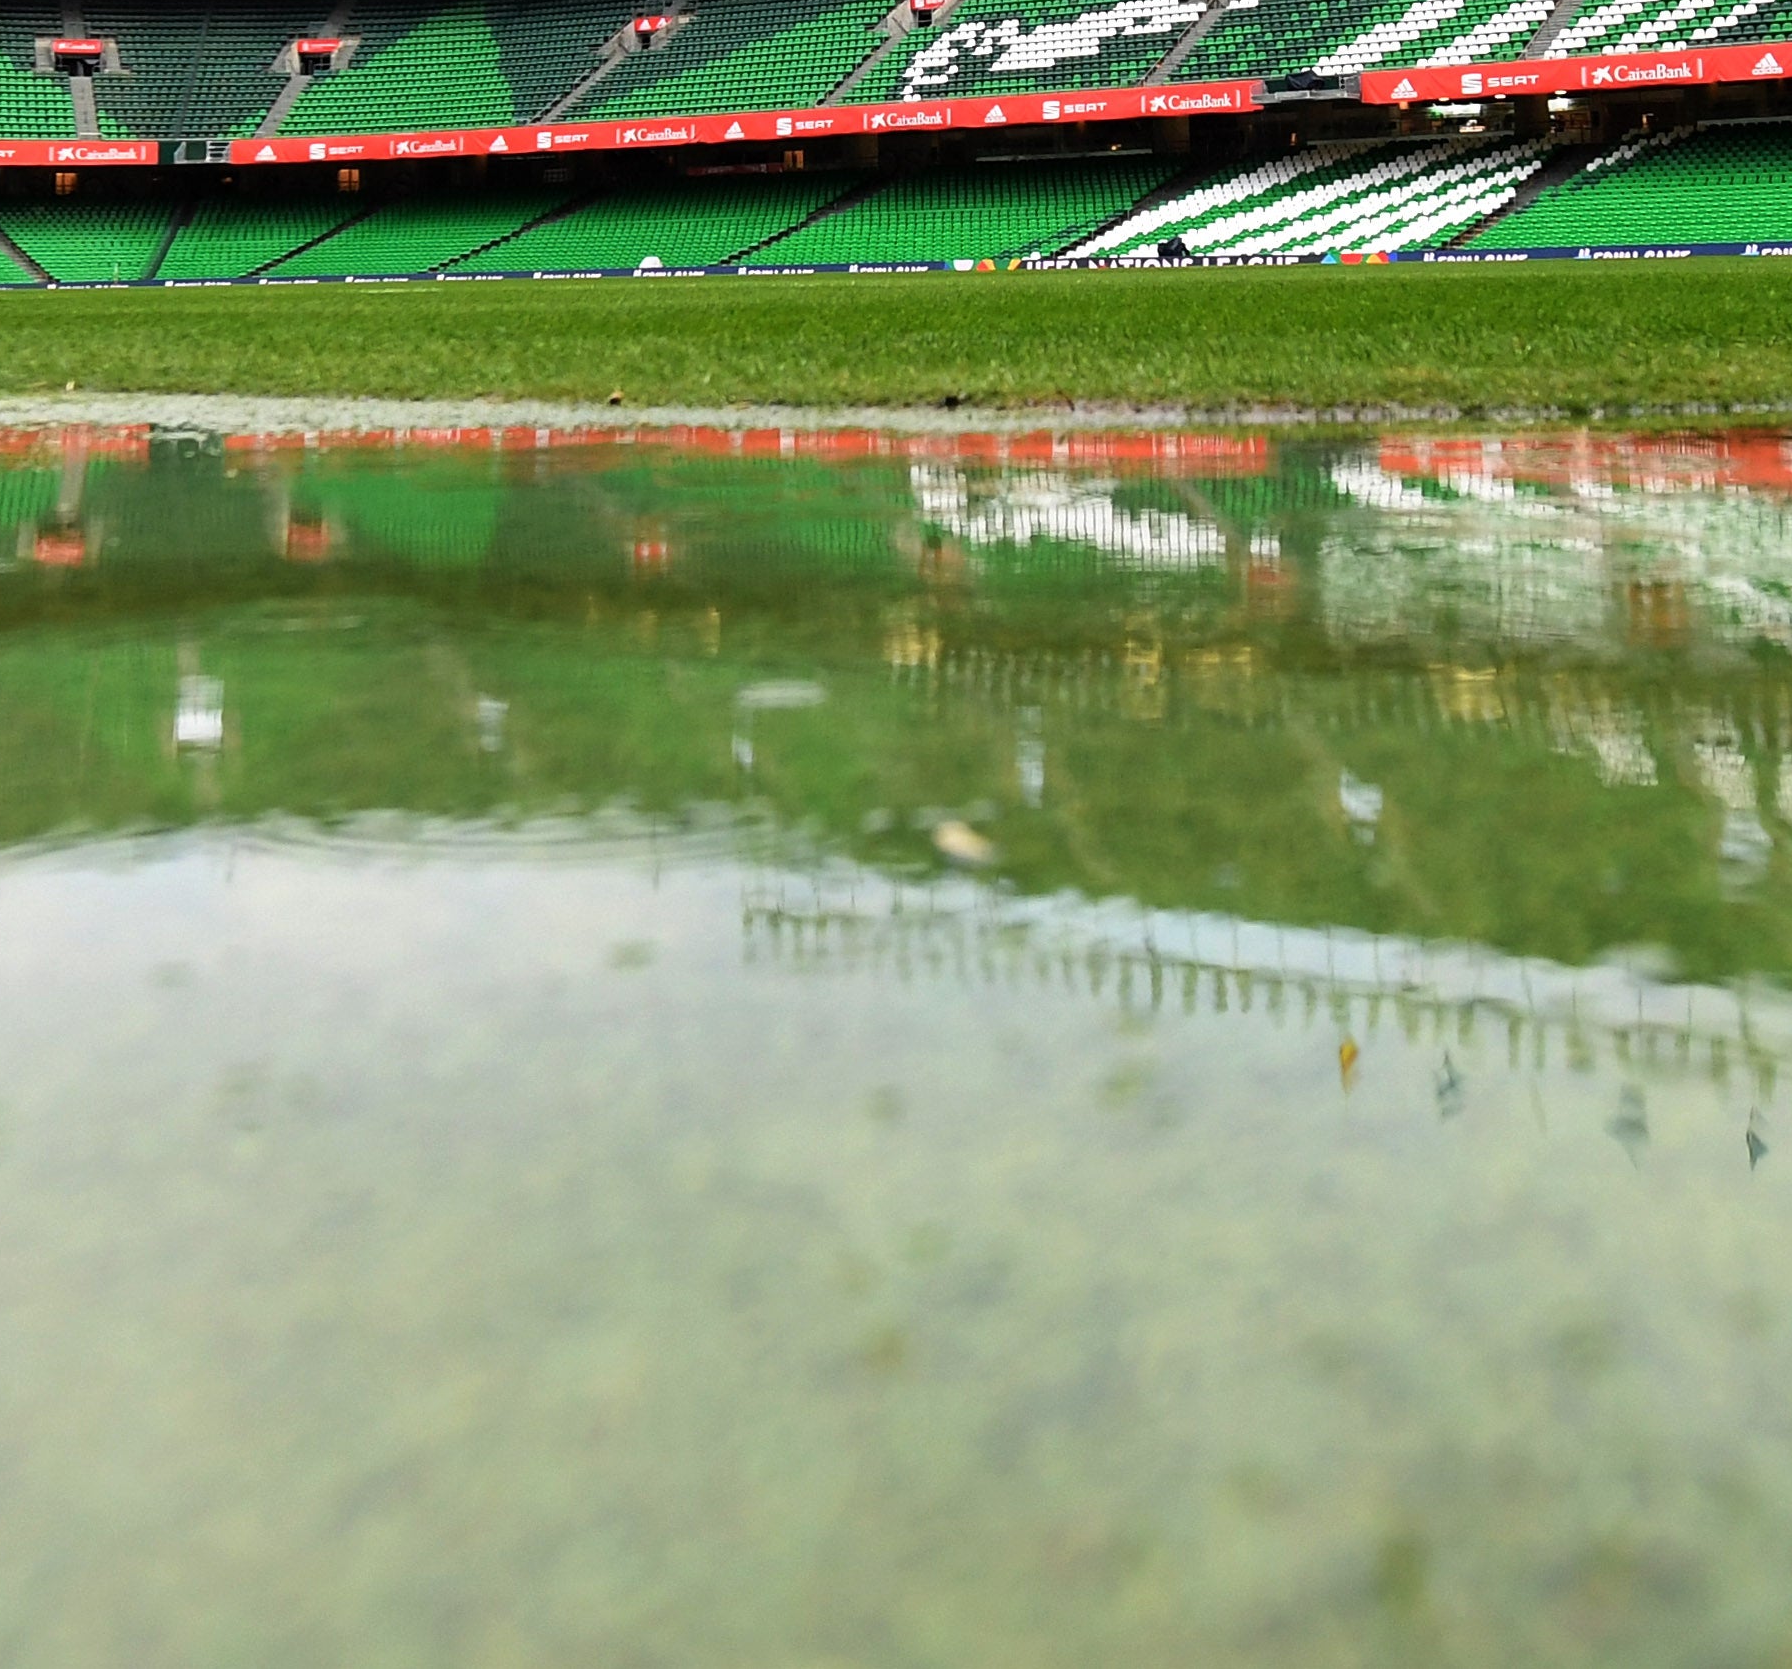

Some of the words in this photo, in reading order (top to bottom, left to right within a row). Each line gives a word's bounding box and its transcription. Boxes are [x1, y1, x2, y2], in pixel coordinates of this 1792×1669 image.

[1613, 62, 1693, 82] CaixaBank
[1486, 74, 1540, 88] SEAT
[1063, 101, 1108, 114] SEAT
[1167, 92, 1233, 111] CaixaBank
[794, 119, 834, 131] SEAT
[886, 110, 944, 127] CaixaBank
[553, 133, 590, 144] SEAT
